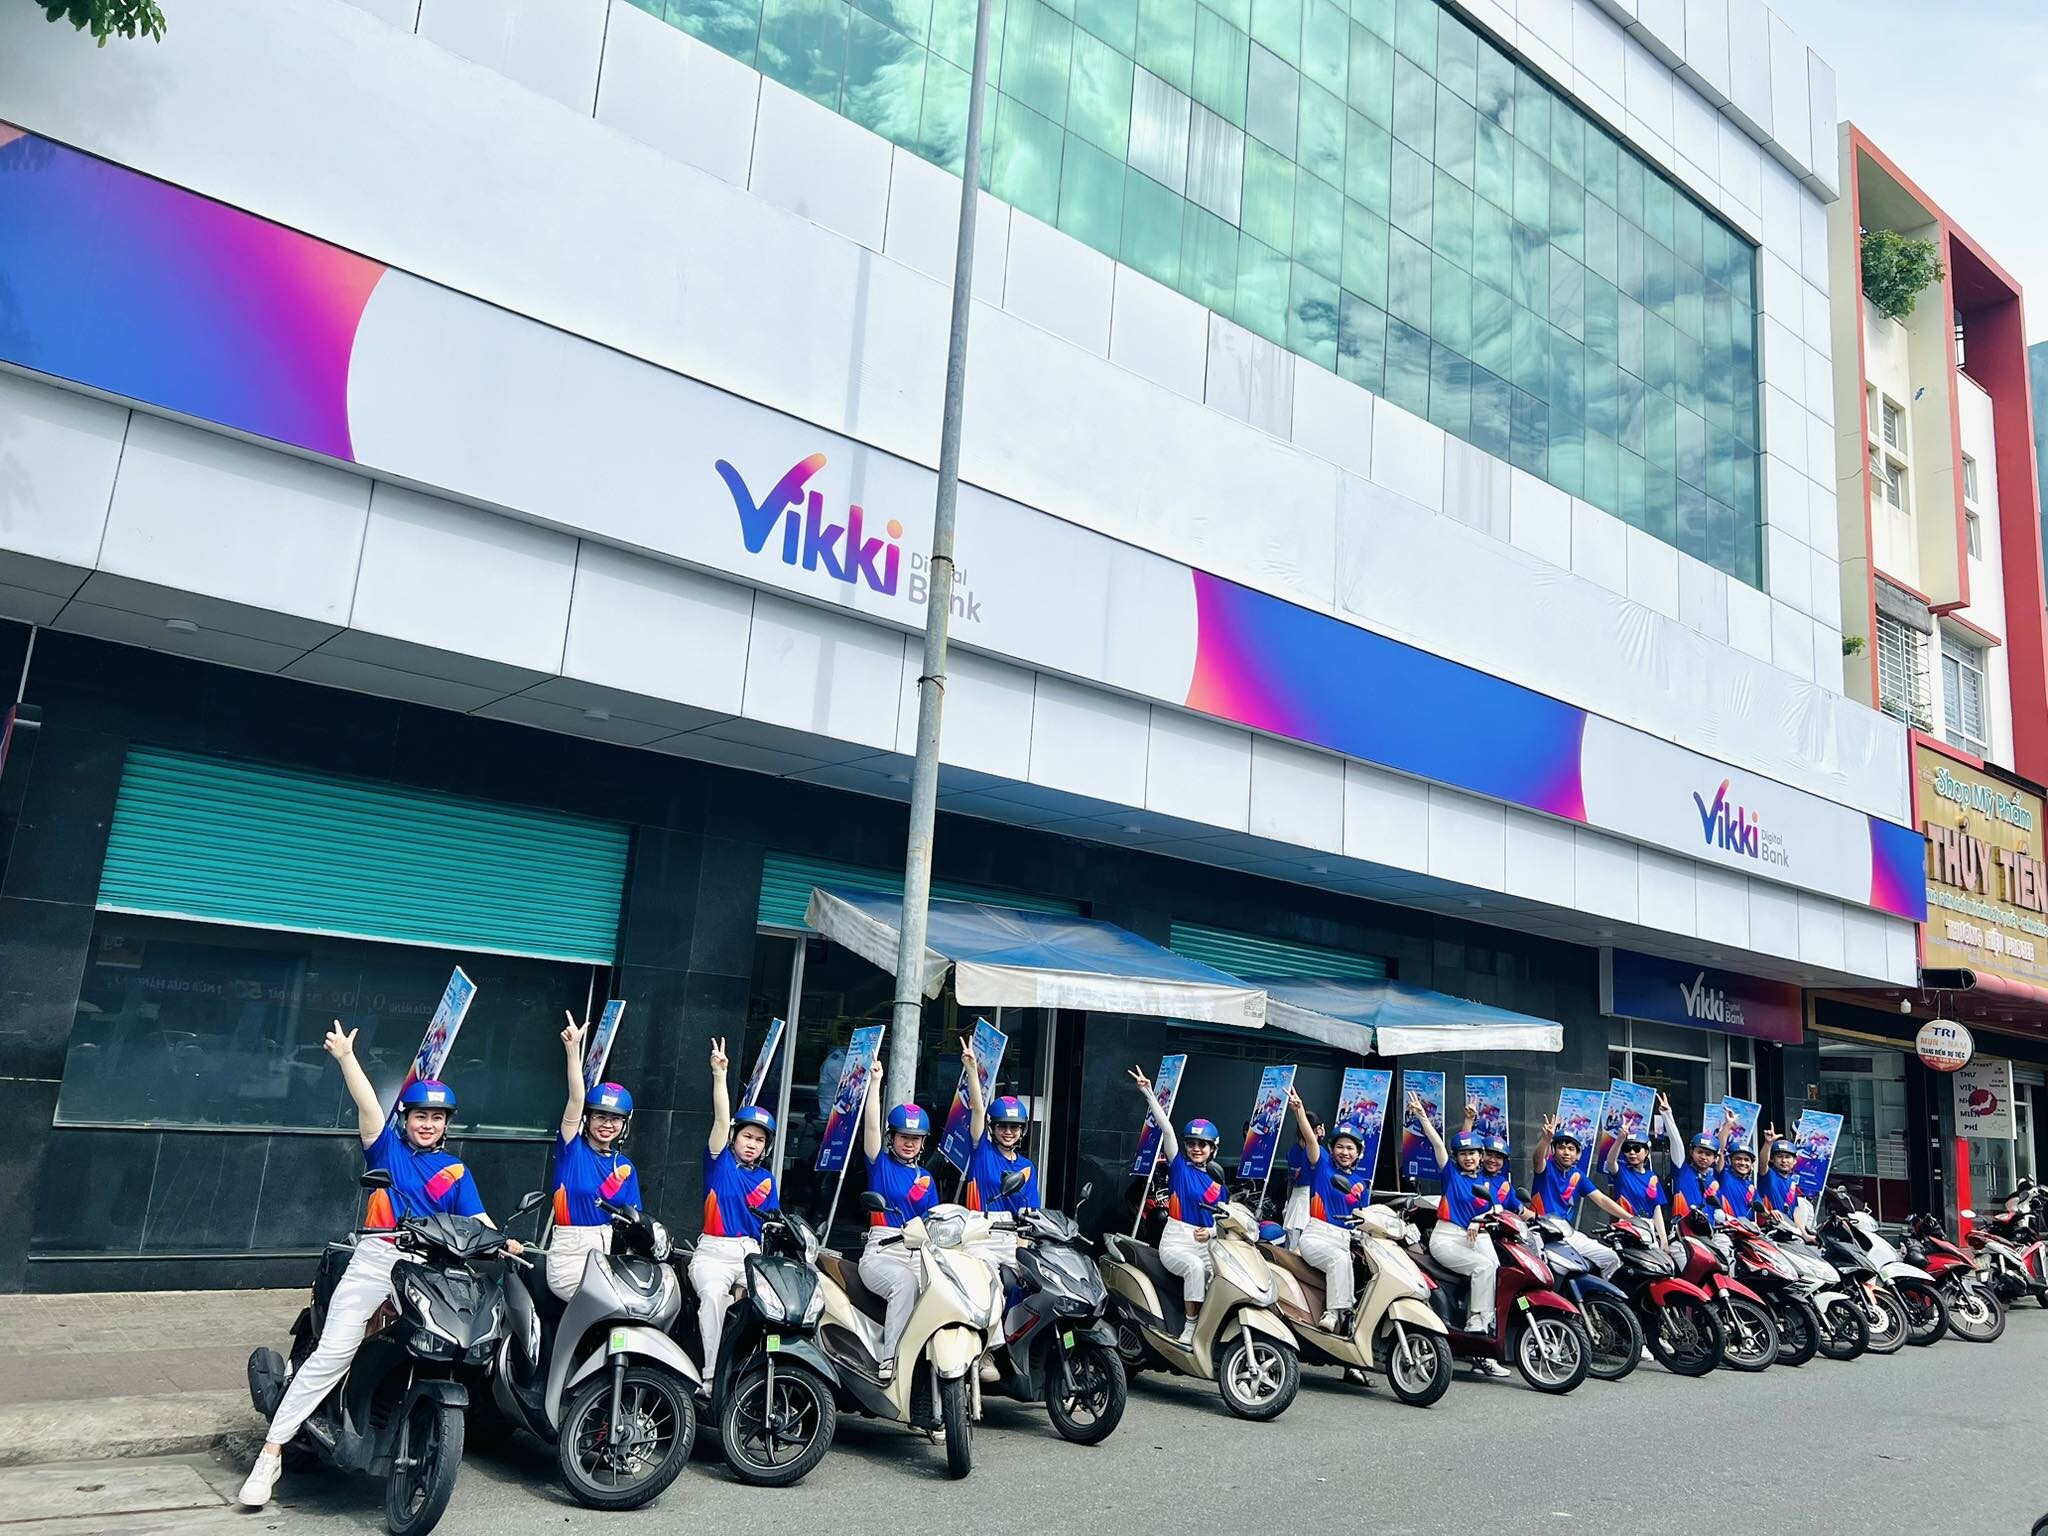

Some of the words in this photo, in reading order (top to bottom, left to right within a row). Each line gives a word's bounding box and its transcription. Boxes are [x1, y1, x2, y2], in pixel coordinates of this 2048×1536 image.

[715, 453, 903, 597] Vikki
[911, 552, 967, 587] Dial
[909, 573, 982, 623] Bnk
[1693, 778, 1758, 859] Vikki
[1935, 767, 1971, 811] Shop
[1972, 783, 1994, 820] Mỹ
[1996, 791, 2032, 832] Phẩm
[1761, 829, 1783, 846] Digital
[1761, 843, 1790, 868] Bank
[1925, 815, 1992, 895] THỦY
[1997, 840, 2048, 914] TIÊN
[1680, 971, 1724, 1022] Vikki
[1725, 1010, 1745, 1025] Bank
